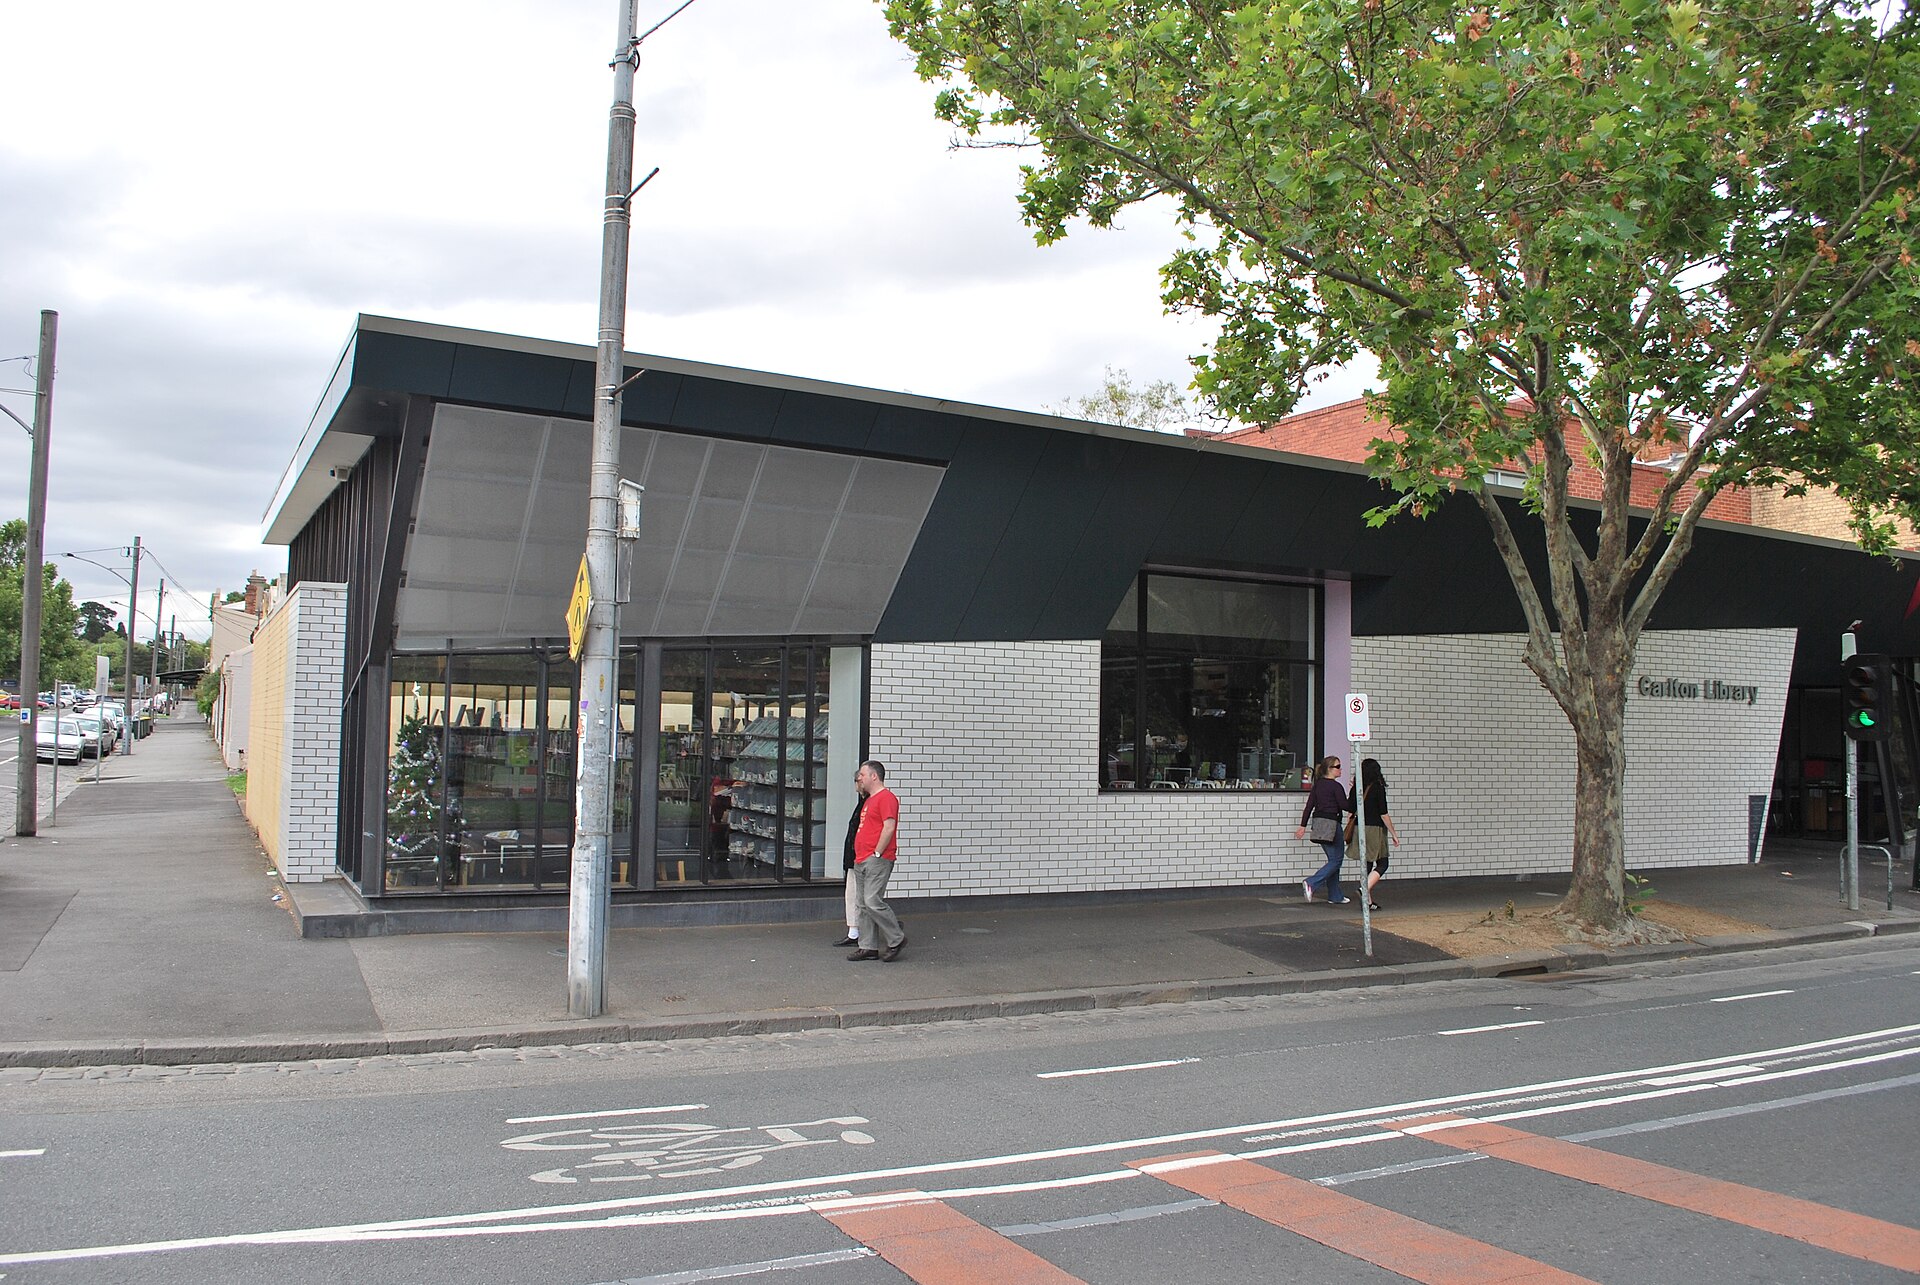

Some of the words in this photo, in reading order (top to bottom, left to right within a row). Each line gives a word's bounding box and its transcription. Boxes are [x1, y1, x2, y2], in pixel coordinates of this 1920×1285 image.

[1639, 675, 1698, 698] Carlton
[1704, 679, 1758, 705] Library
[1353, 700, 1361, 711] S
